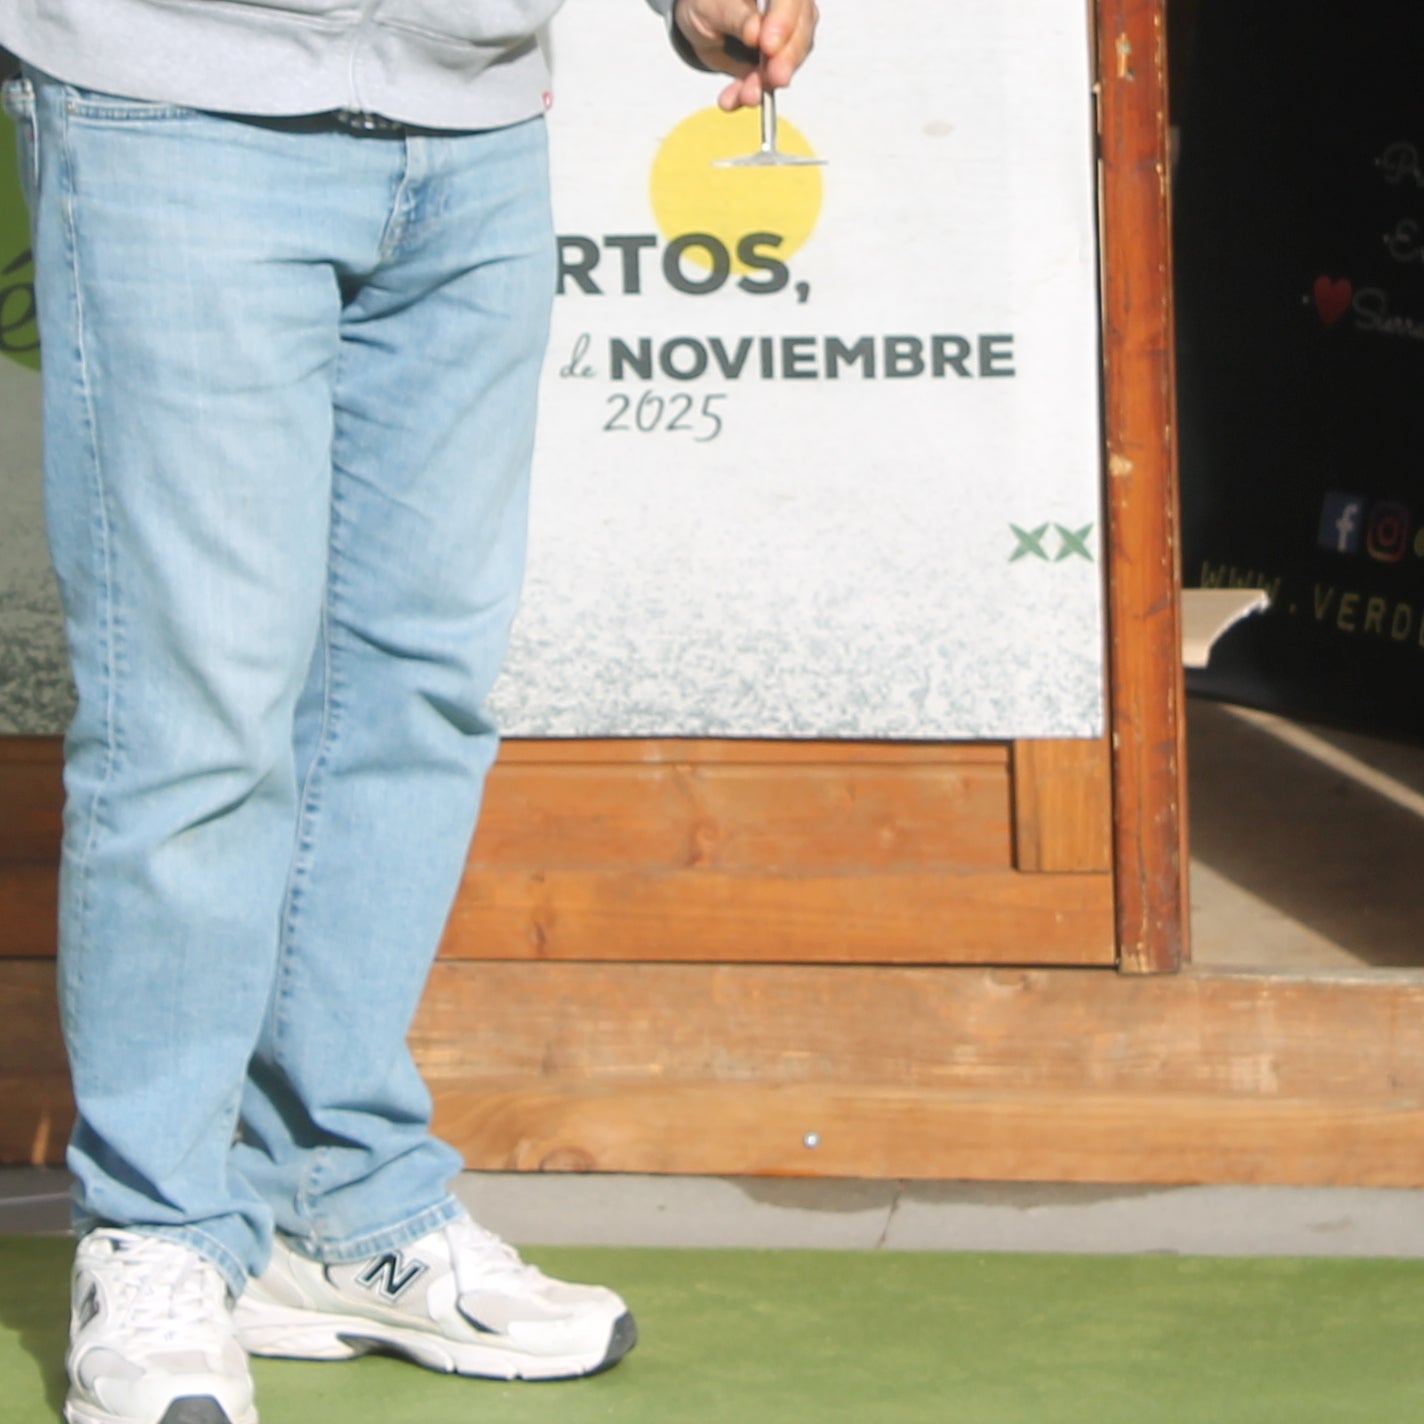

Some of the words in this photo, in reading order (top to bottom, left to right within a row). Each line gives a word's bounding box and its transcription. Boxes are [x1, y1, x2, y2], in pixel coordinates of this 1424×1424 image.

[555, 231, 811, 304] RTOS,
[559, 333, 596, 379] de
[609, 334, 1016, 381] NOVIEMBRE
[602, 388, 727, 442] 2025
